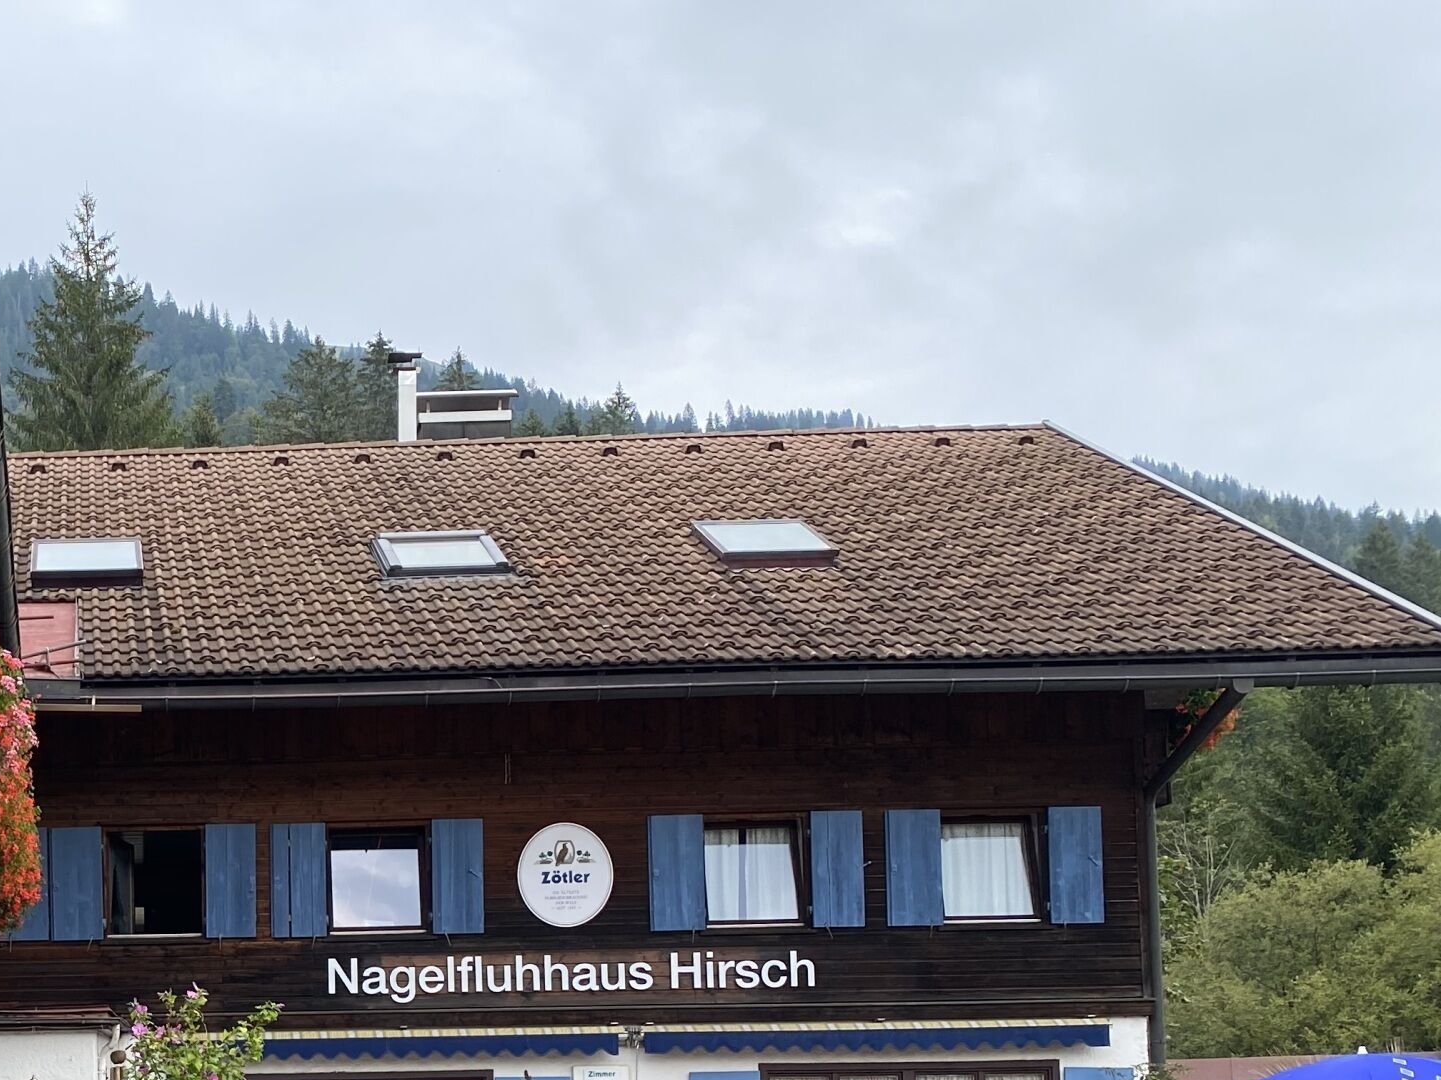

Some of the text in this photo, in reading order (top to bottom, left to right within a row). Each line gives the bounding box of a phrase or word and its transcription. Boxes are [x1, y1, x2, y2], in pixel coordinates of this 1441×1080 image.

[541, 870, 590, 885] Zötler
[326, 951, 816, 1004] Nagelfluhhaus Hirsch
